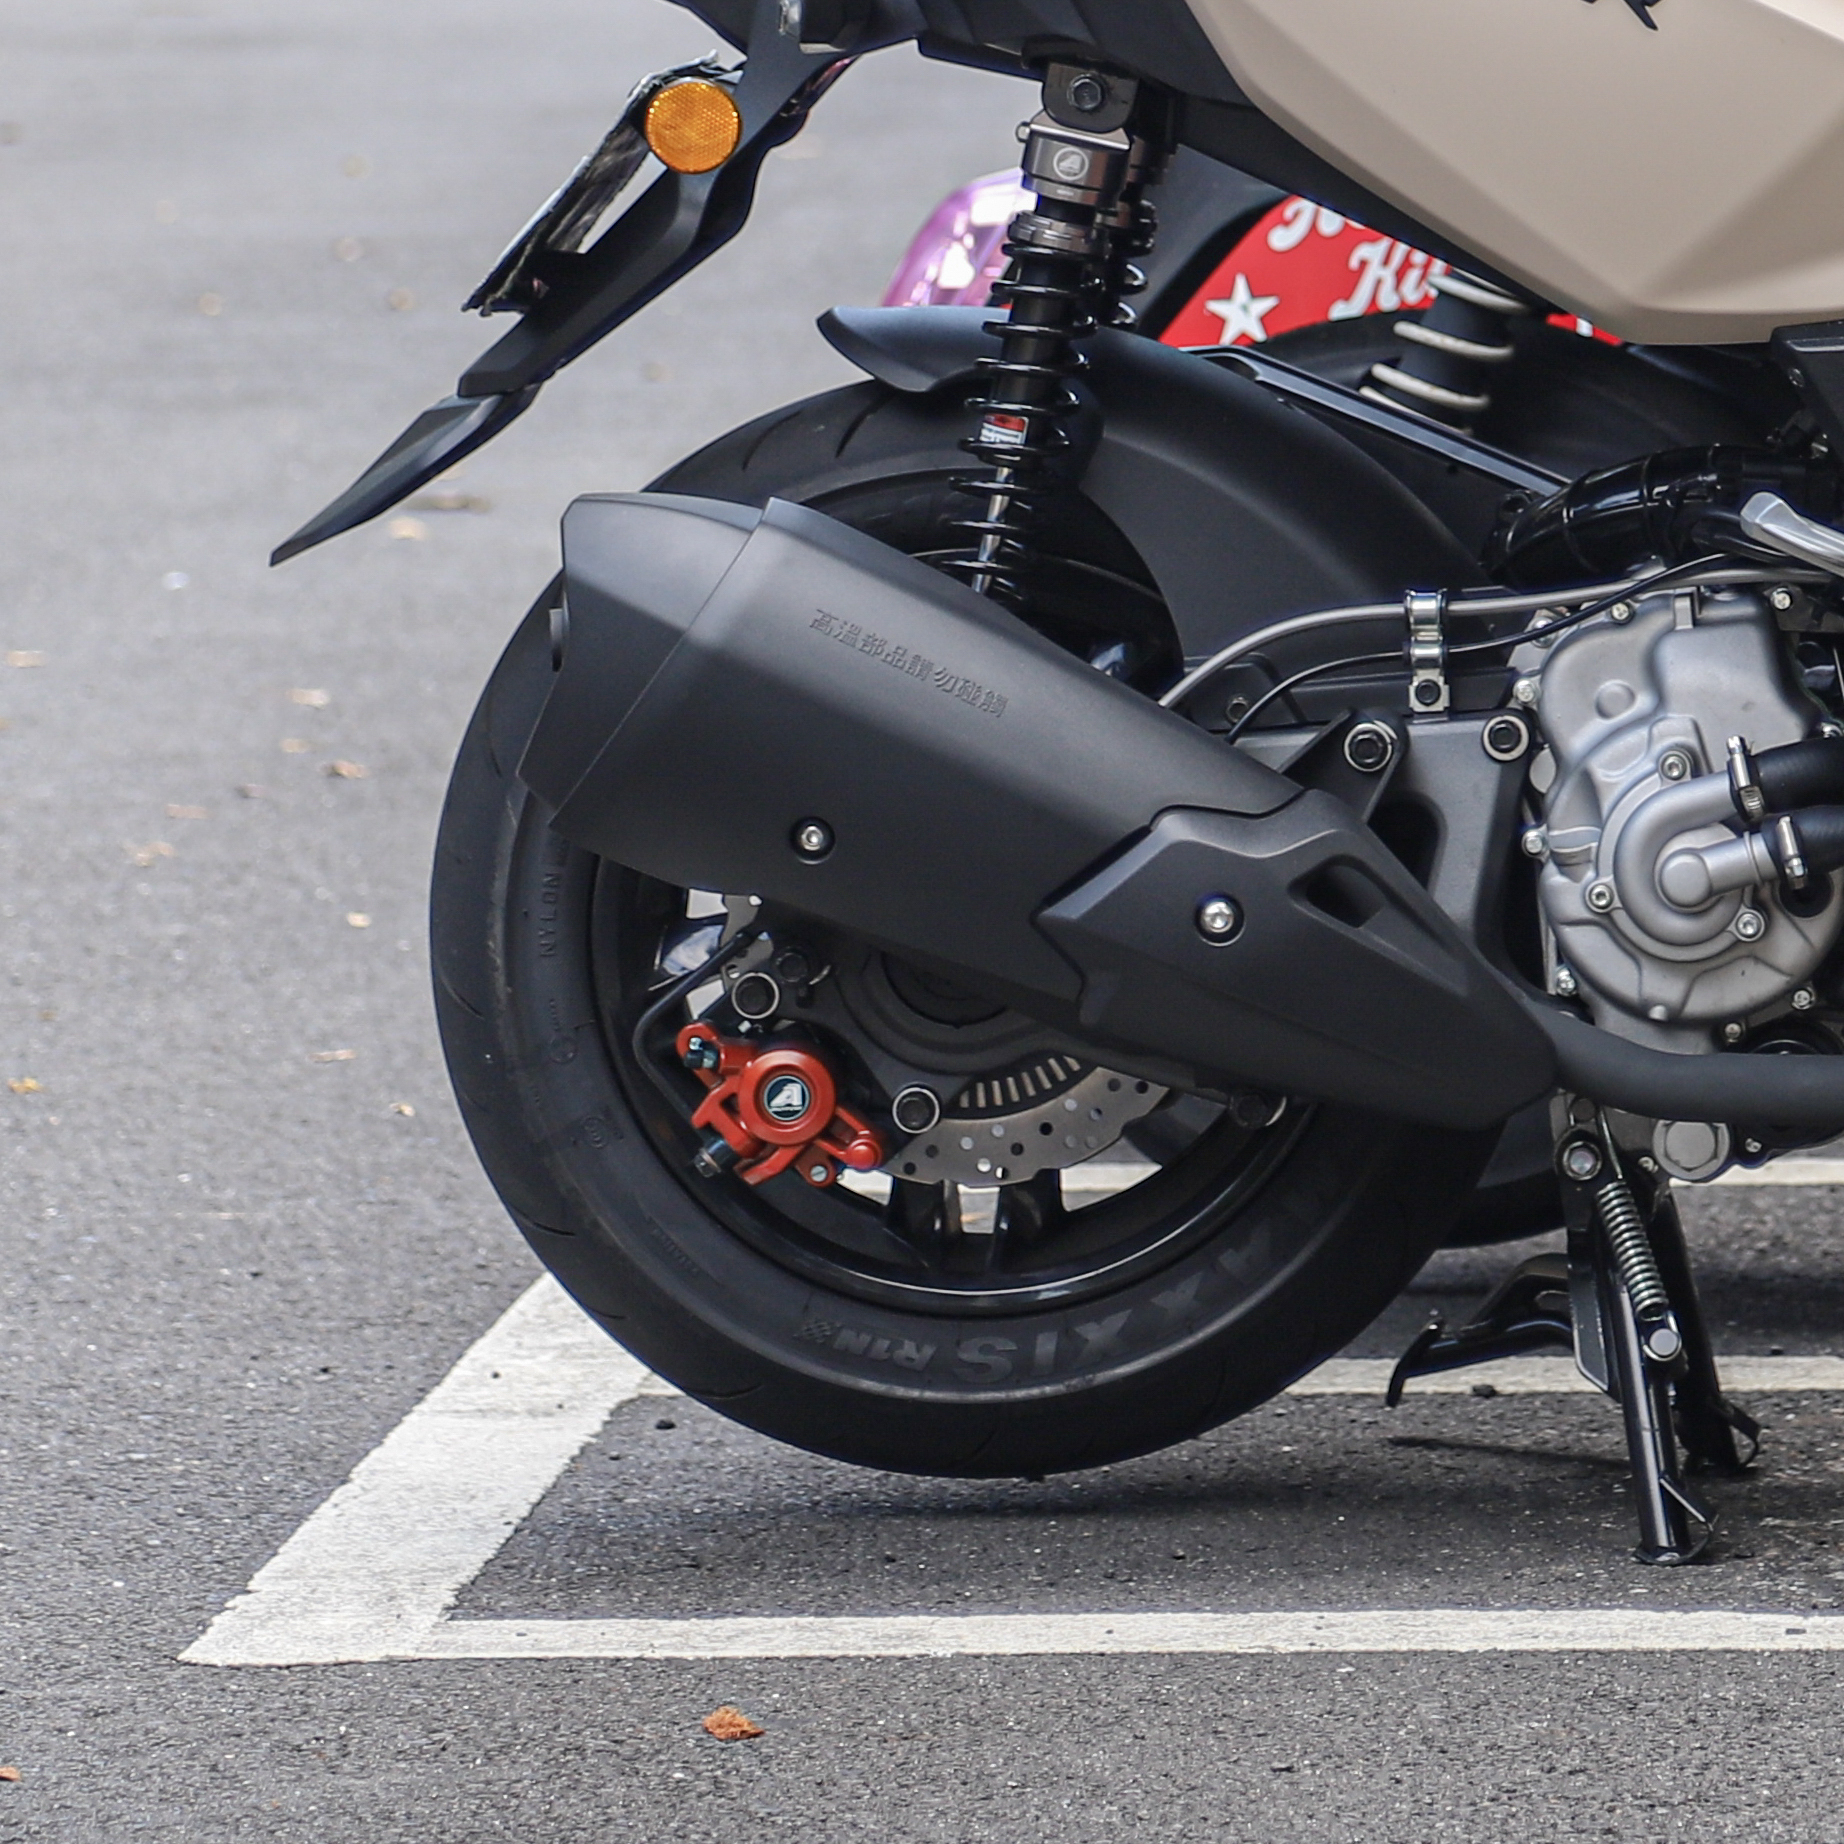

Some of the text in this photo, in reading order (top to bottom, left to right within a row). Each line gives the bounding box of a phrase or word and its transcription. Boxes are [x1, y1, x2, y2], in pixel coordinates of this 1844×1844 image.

[809, 609, 1010, 718] 高溫部品請勿碰觸
[538, 872, 561, 957] NYLON
